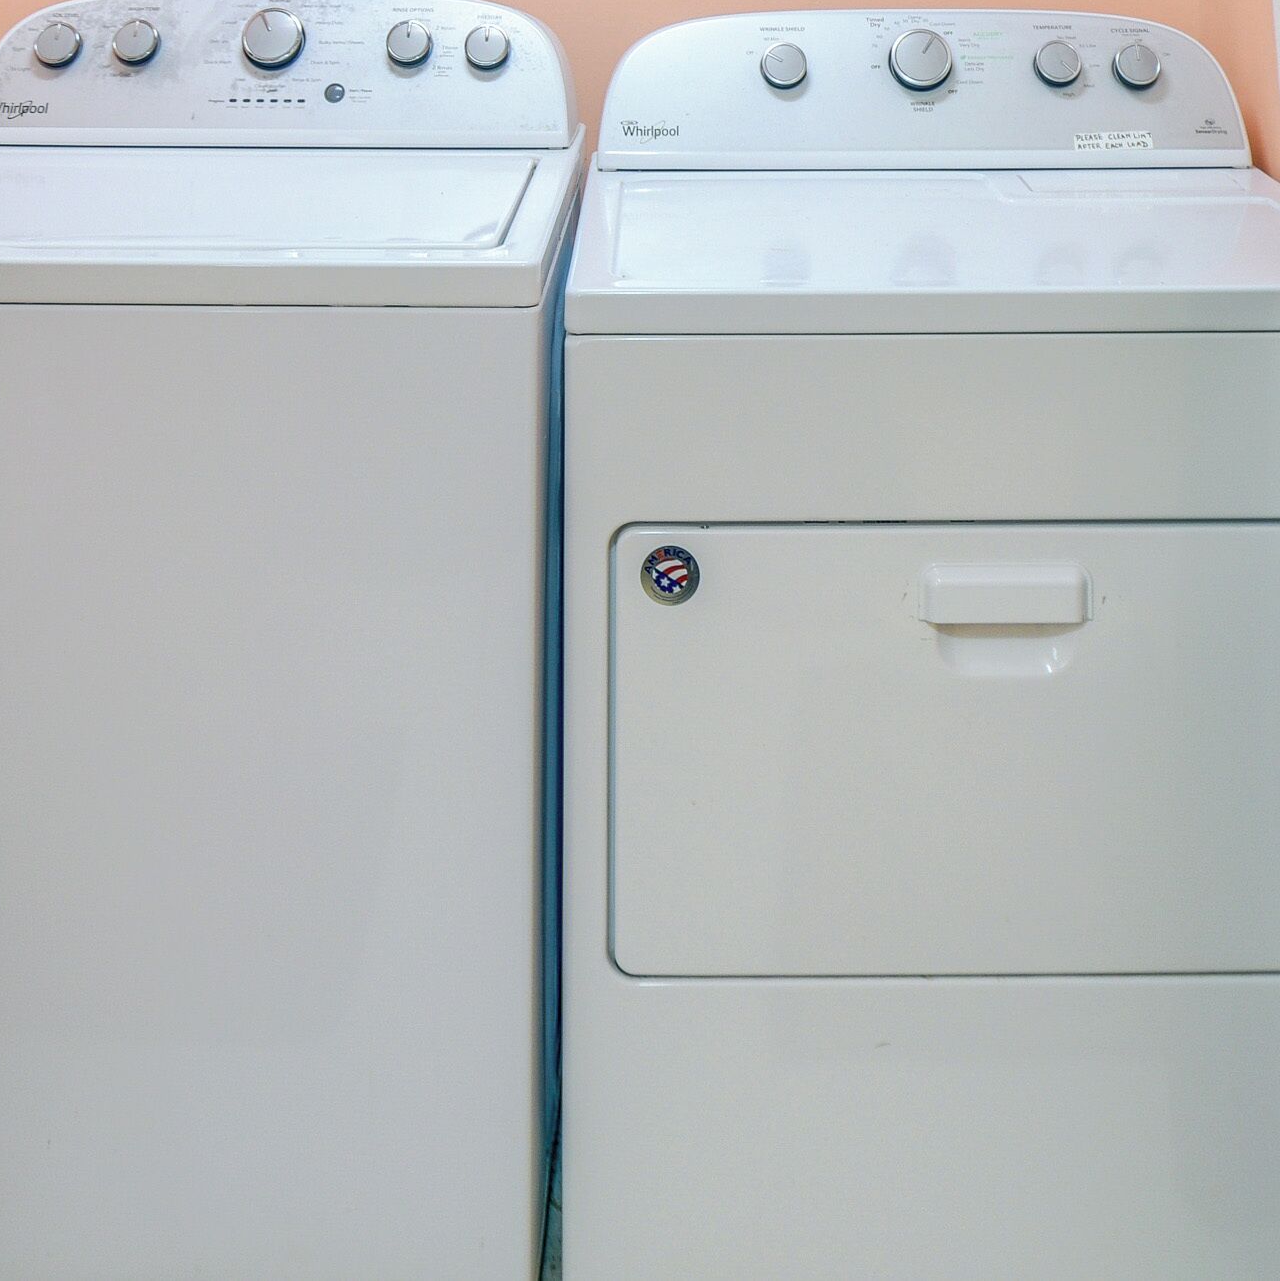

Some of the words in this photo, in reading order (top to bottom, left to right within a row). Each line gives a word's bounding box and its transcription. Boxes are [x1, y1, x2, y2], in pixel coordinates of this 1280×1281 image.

[622, 125, 680, 140] Whirlpool
[1075, 133, 1103, 142] PLEASE
[1105, 142, 1123, 150] EACH
[644, 548, 691, 575] AMERICA
